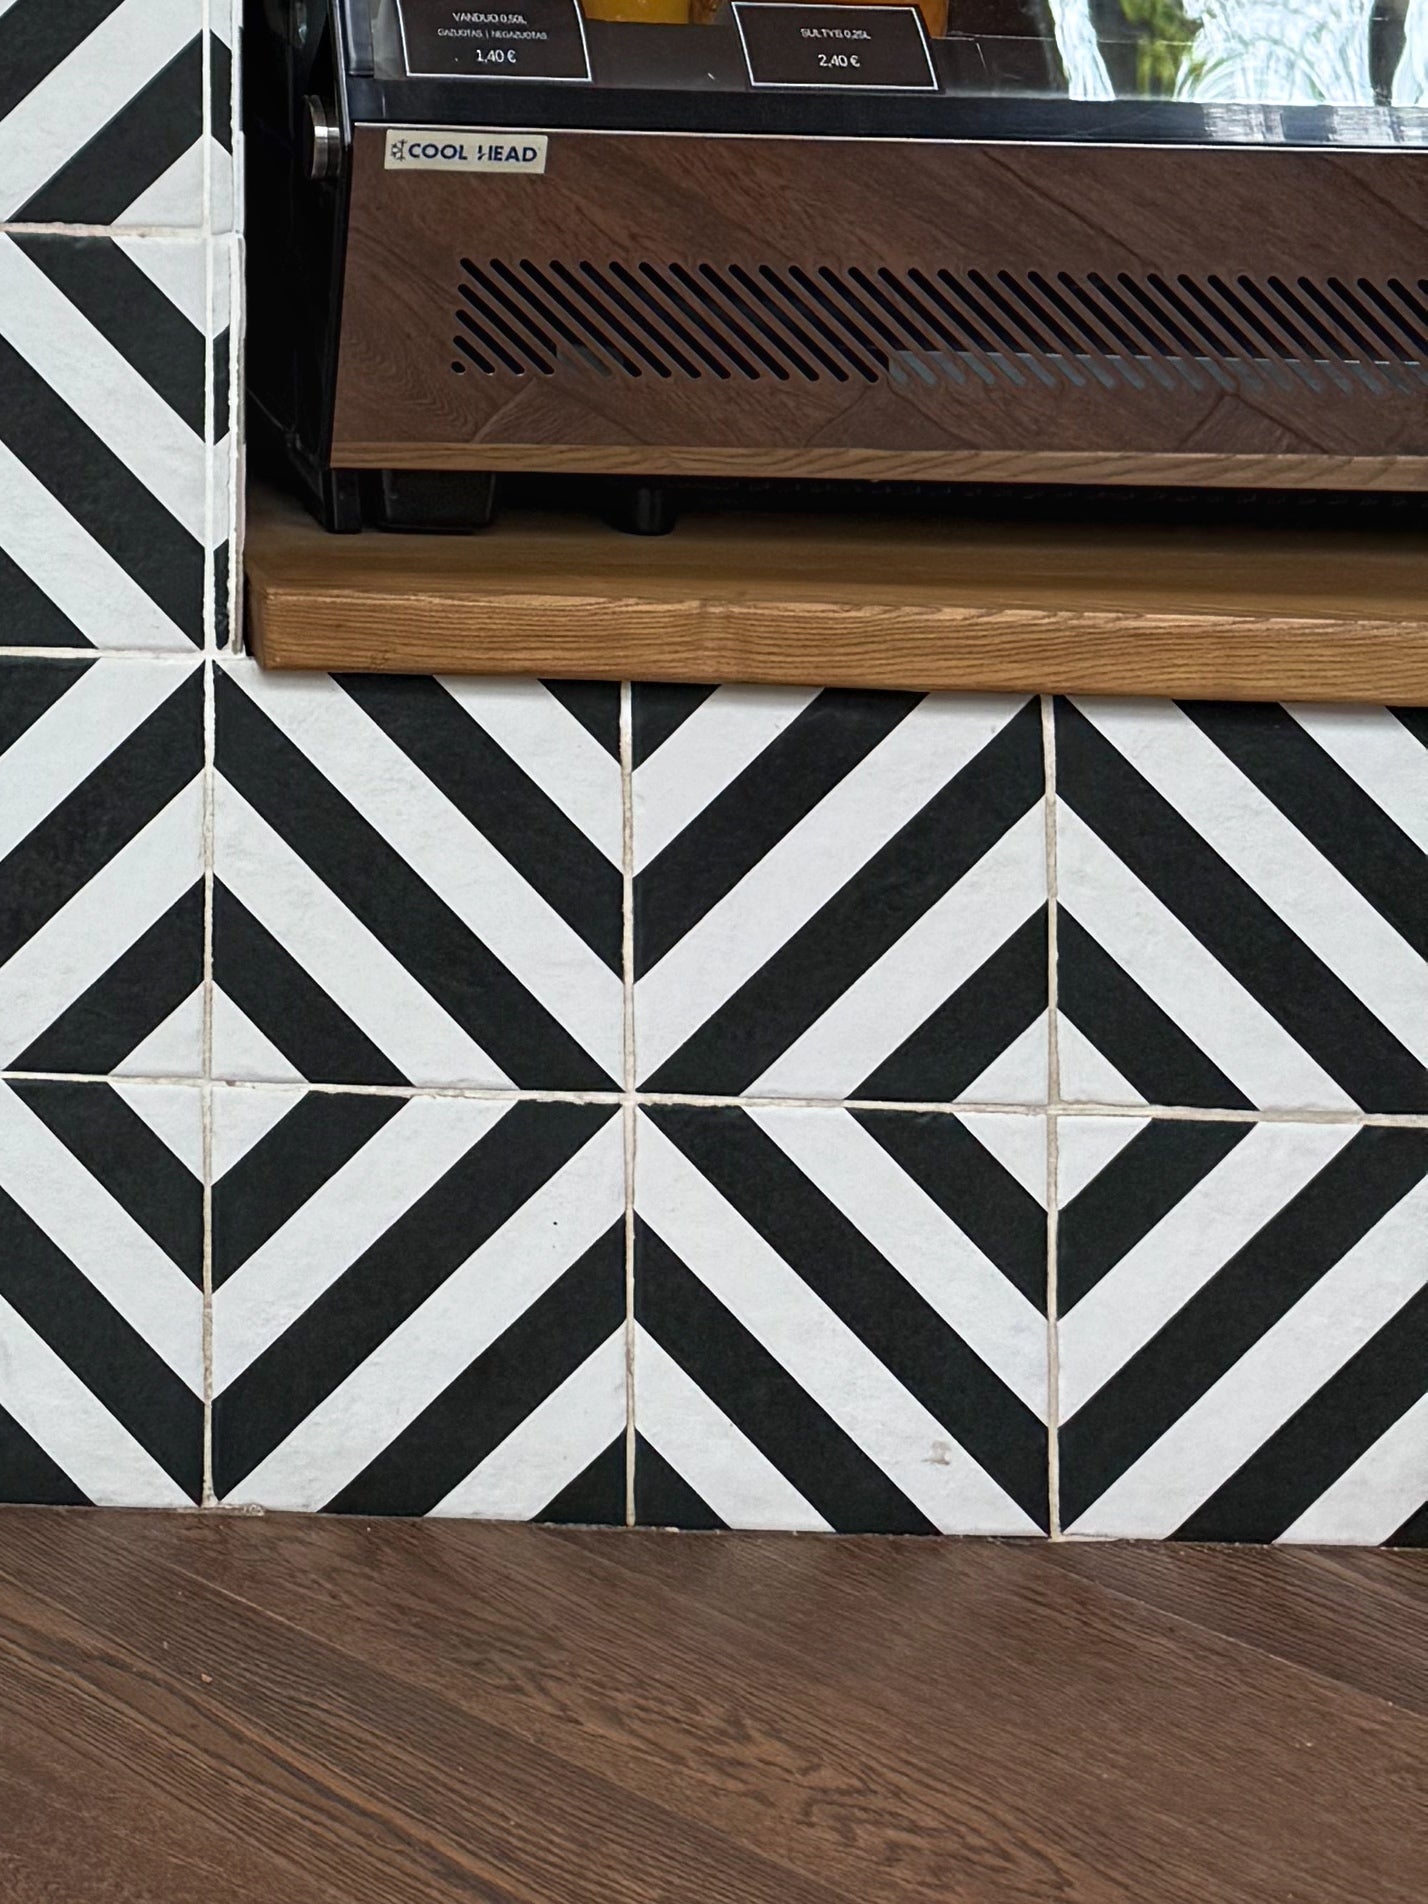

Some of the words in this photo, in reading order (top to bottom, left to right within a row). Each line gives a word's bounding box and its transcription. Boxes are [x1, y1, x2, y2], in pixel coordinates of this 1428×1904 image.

[452, 12, 499, 23] VANDUO
[476, 49, 504, 63] 1,40
[507, 50, 516, 63] €
[818, 54, 848, 68] 2,40
[850, 55, 860, 68] €
[408, 143, 468, 160] COOL
